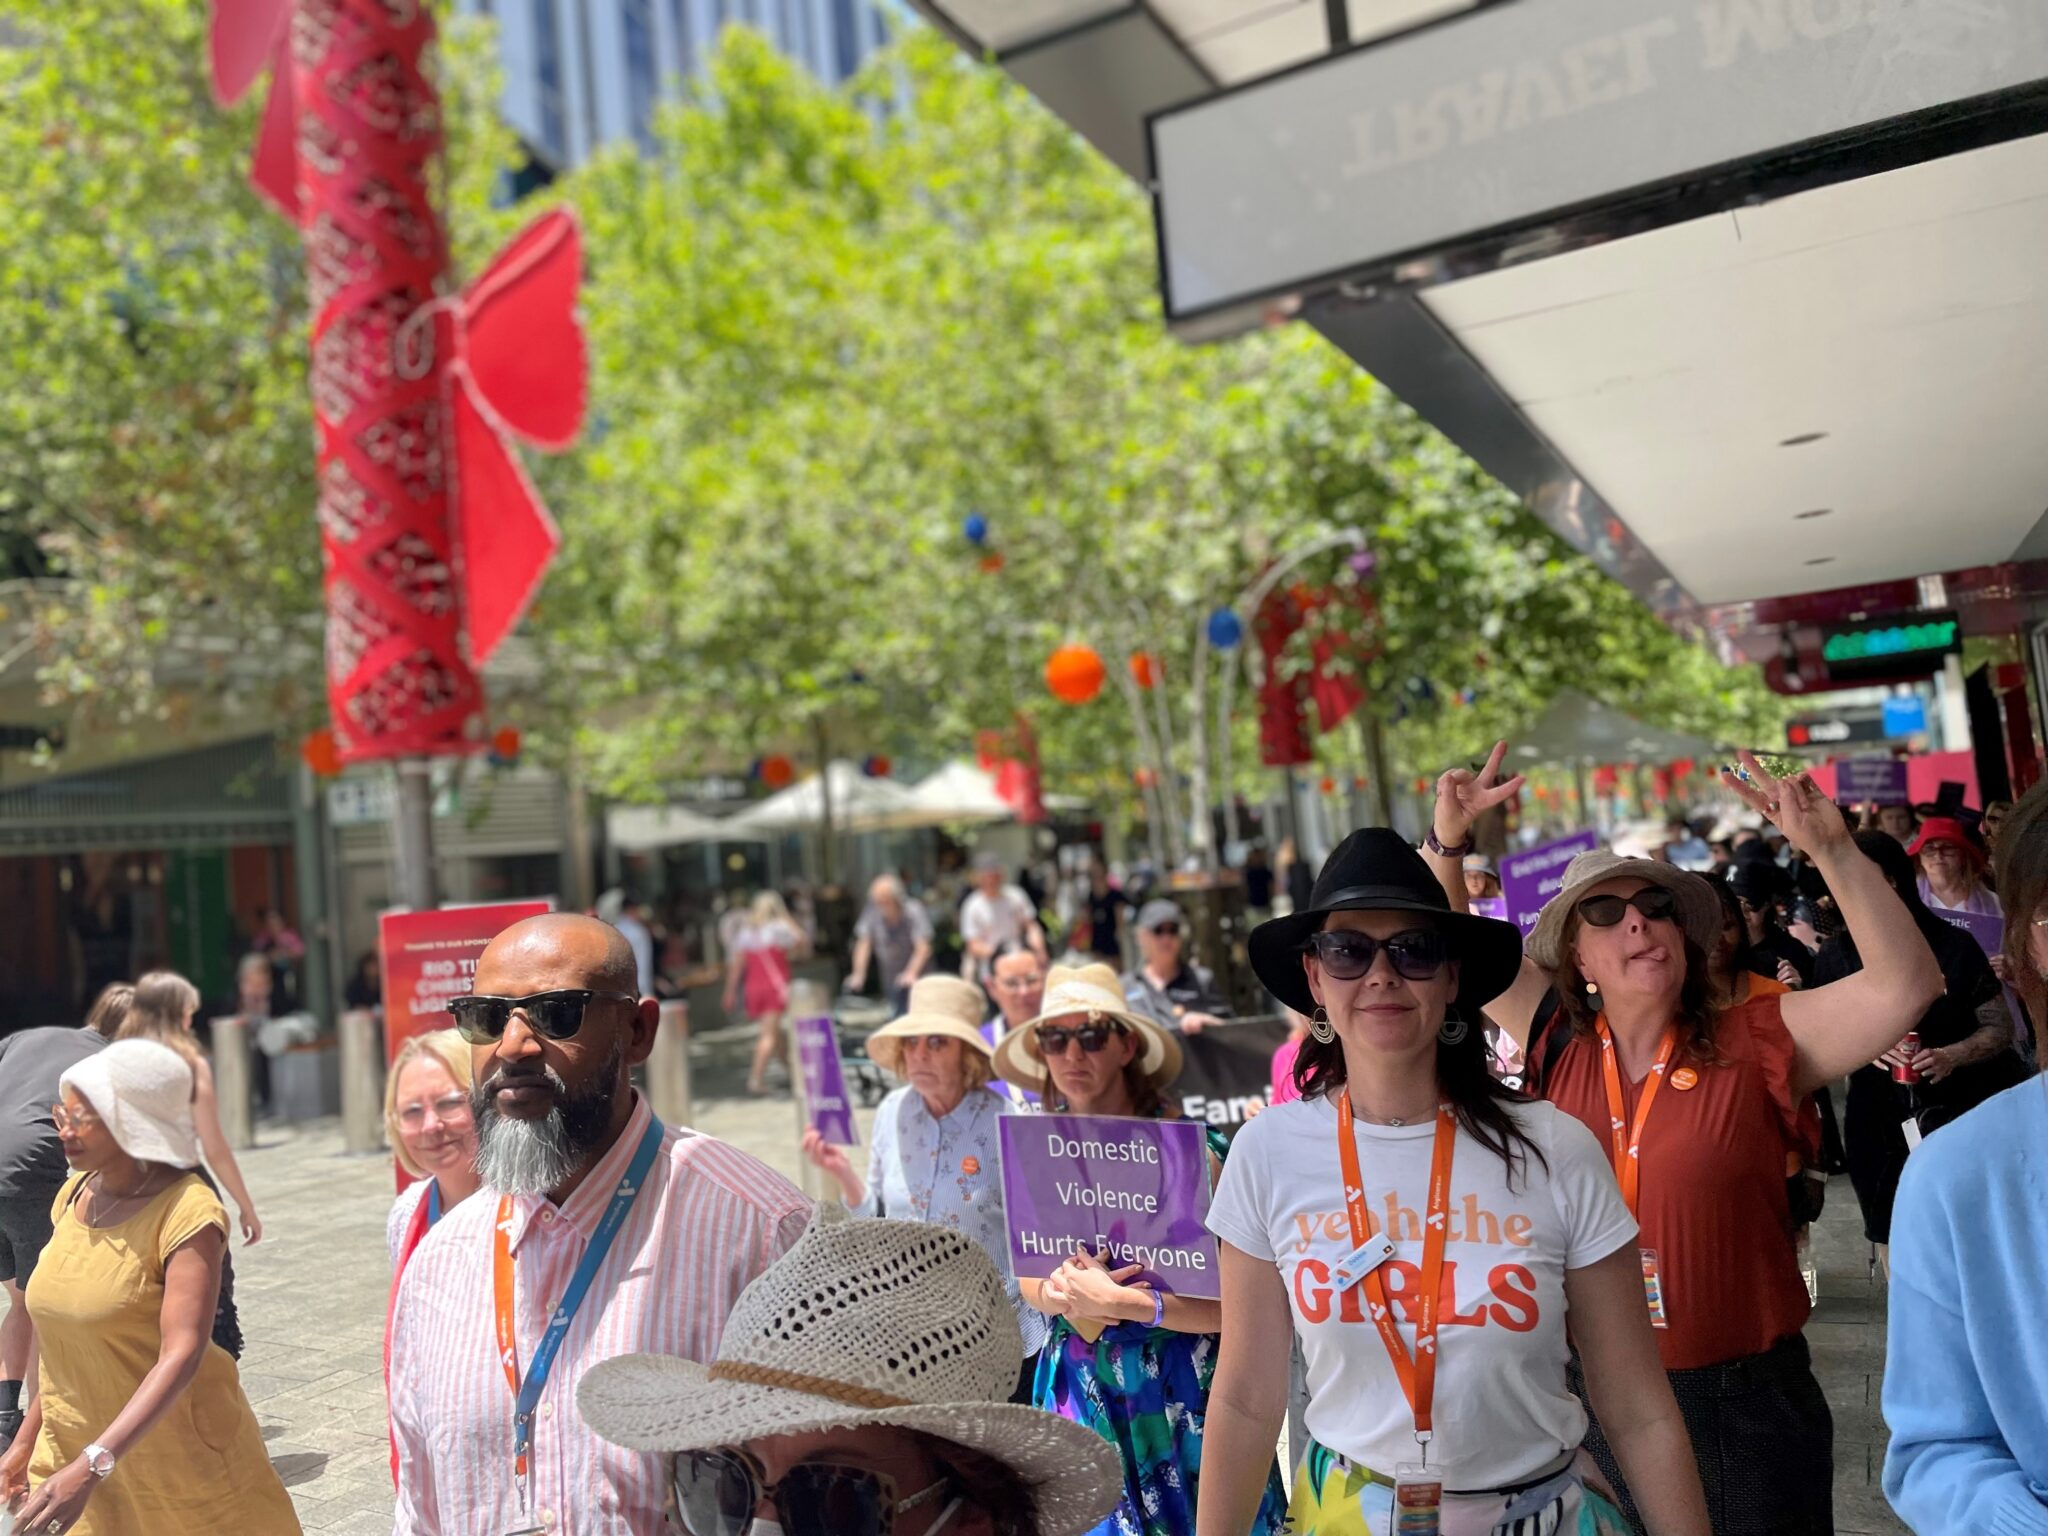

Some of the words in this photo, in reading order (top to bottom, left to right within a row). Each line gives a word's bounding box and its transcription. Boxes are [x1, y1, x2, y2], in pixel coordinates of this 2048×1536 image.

[458, 959, 479, 974] TI
[416, 977, 474, 995] CHRIS
[1048, 1134, 1158, 1164] Domestic
[1056, 1182, 1158, 1213] Violence
[1095, 1234, 1206, 1270] Everyone
